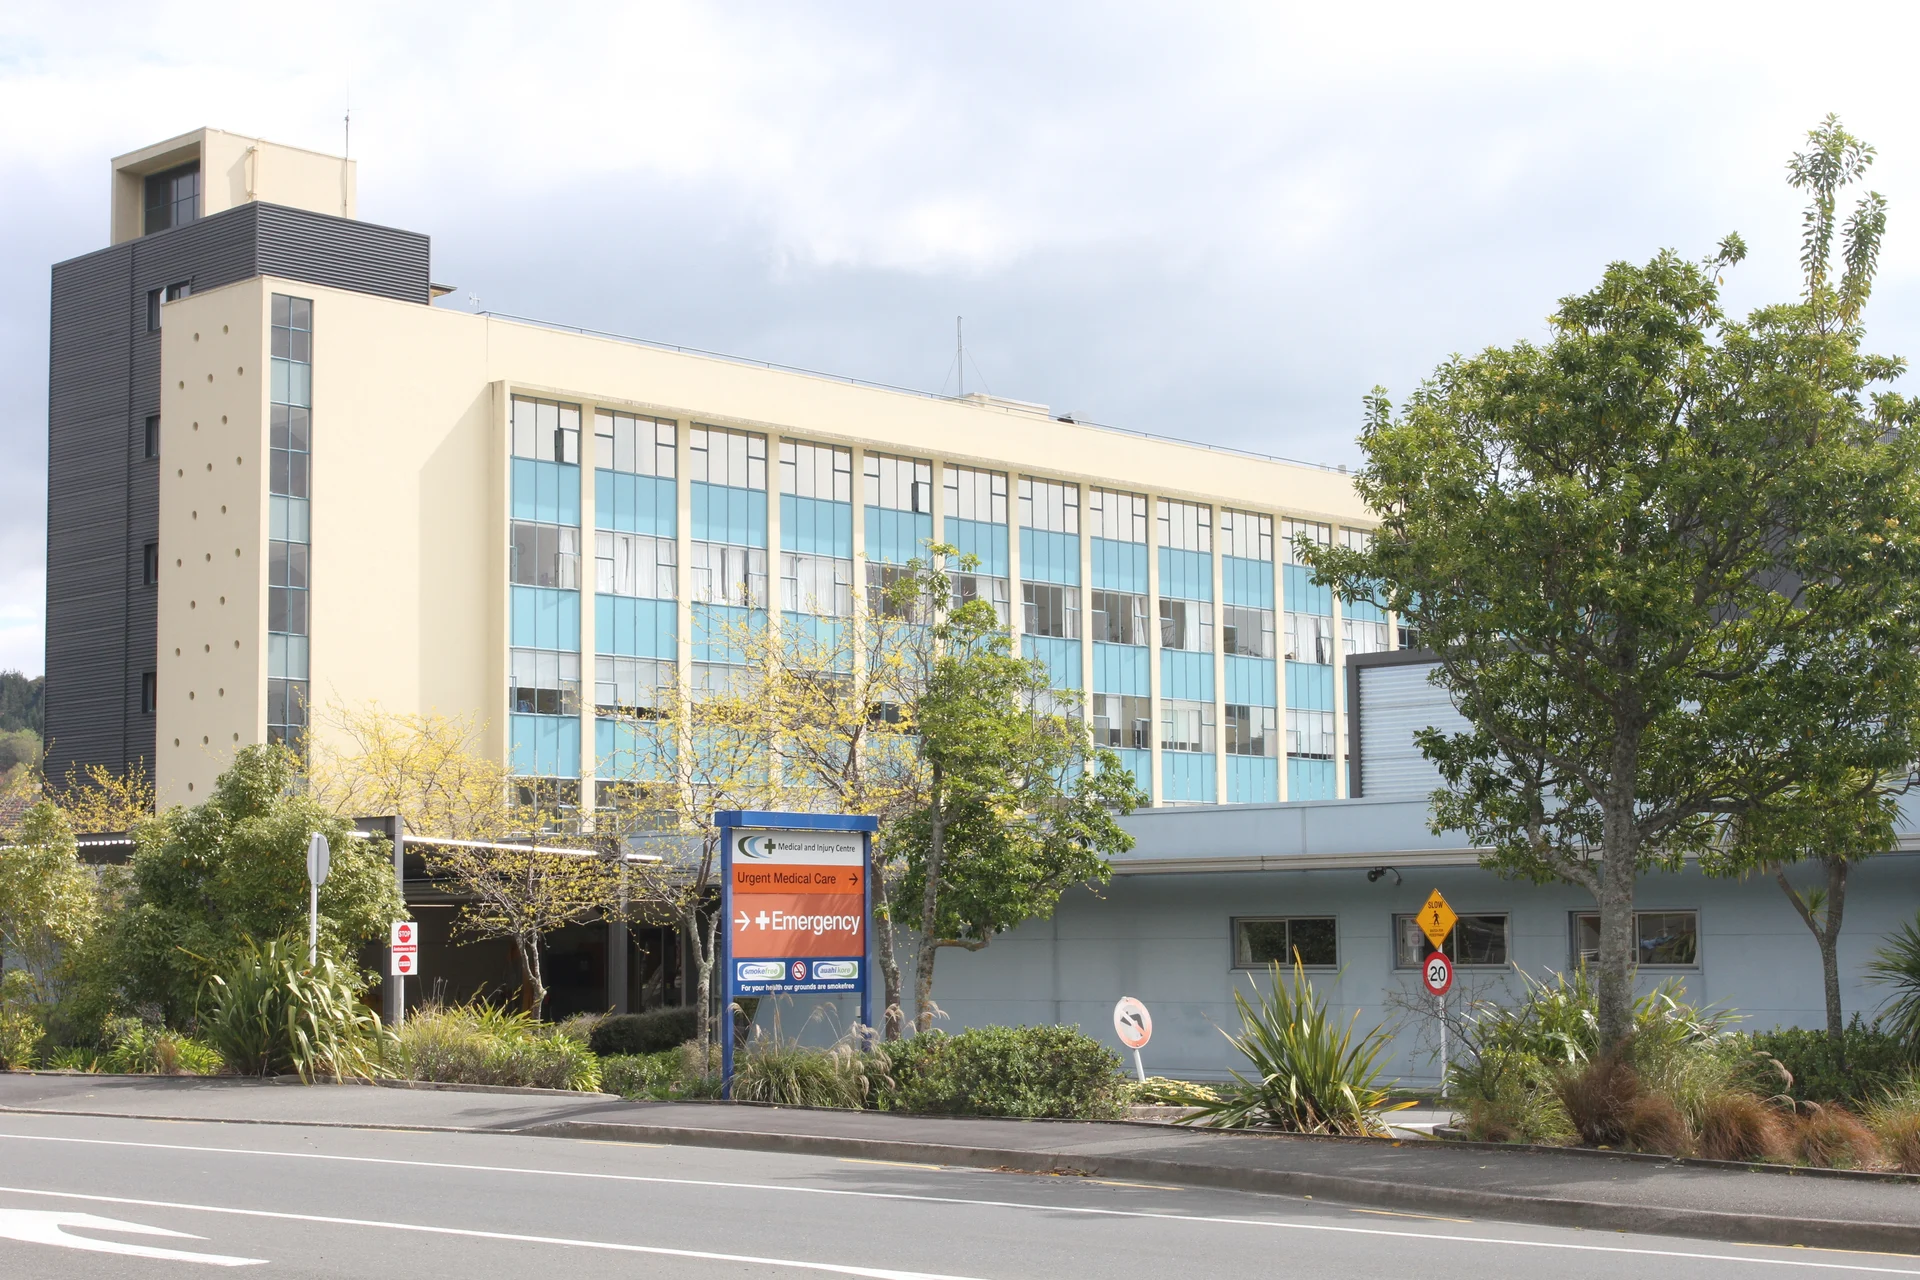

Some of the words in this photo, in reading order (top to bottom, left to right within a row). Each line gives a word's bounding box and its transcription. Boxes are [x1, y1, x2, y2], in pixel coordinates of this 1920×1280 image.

[778, 842, 802, 851] Medical
[817, 844, 834, 853] Injury
[738, 872, 771, 886] Urgent
[774, 873, 811, 884] Medical
[814, 873, 836, 884] Care
[772, 911, 860, 935] Emergency
[744, 966, 778, 975] smokefree
[820, 966, 837, 974] auahi
[837, 966, 850, 974] kore
[1430, 966, 1446, 981] 20
[794, 983, 816, 992] grounds
